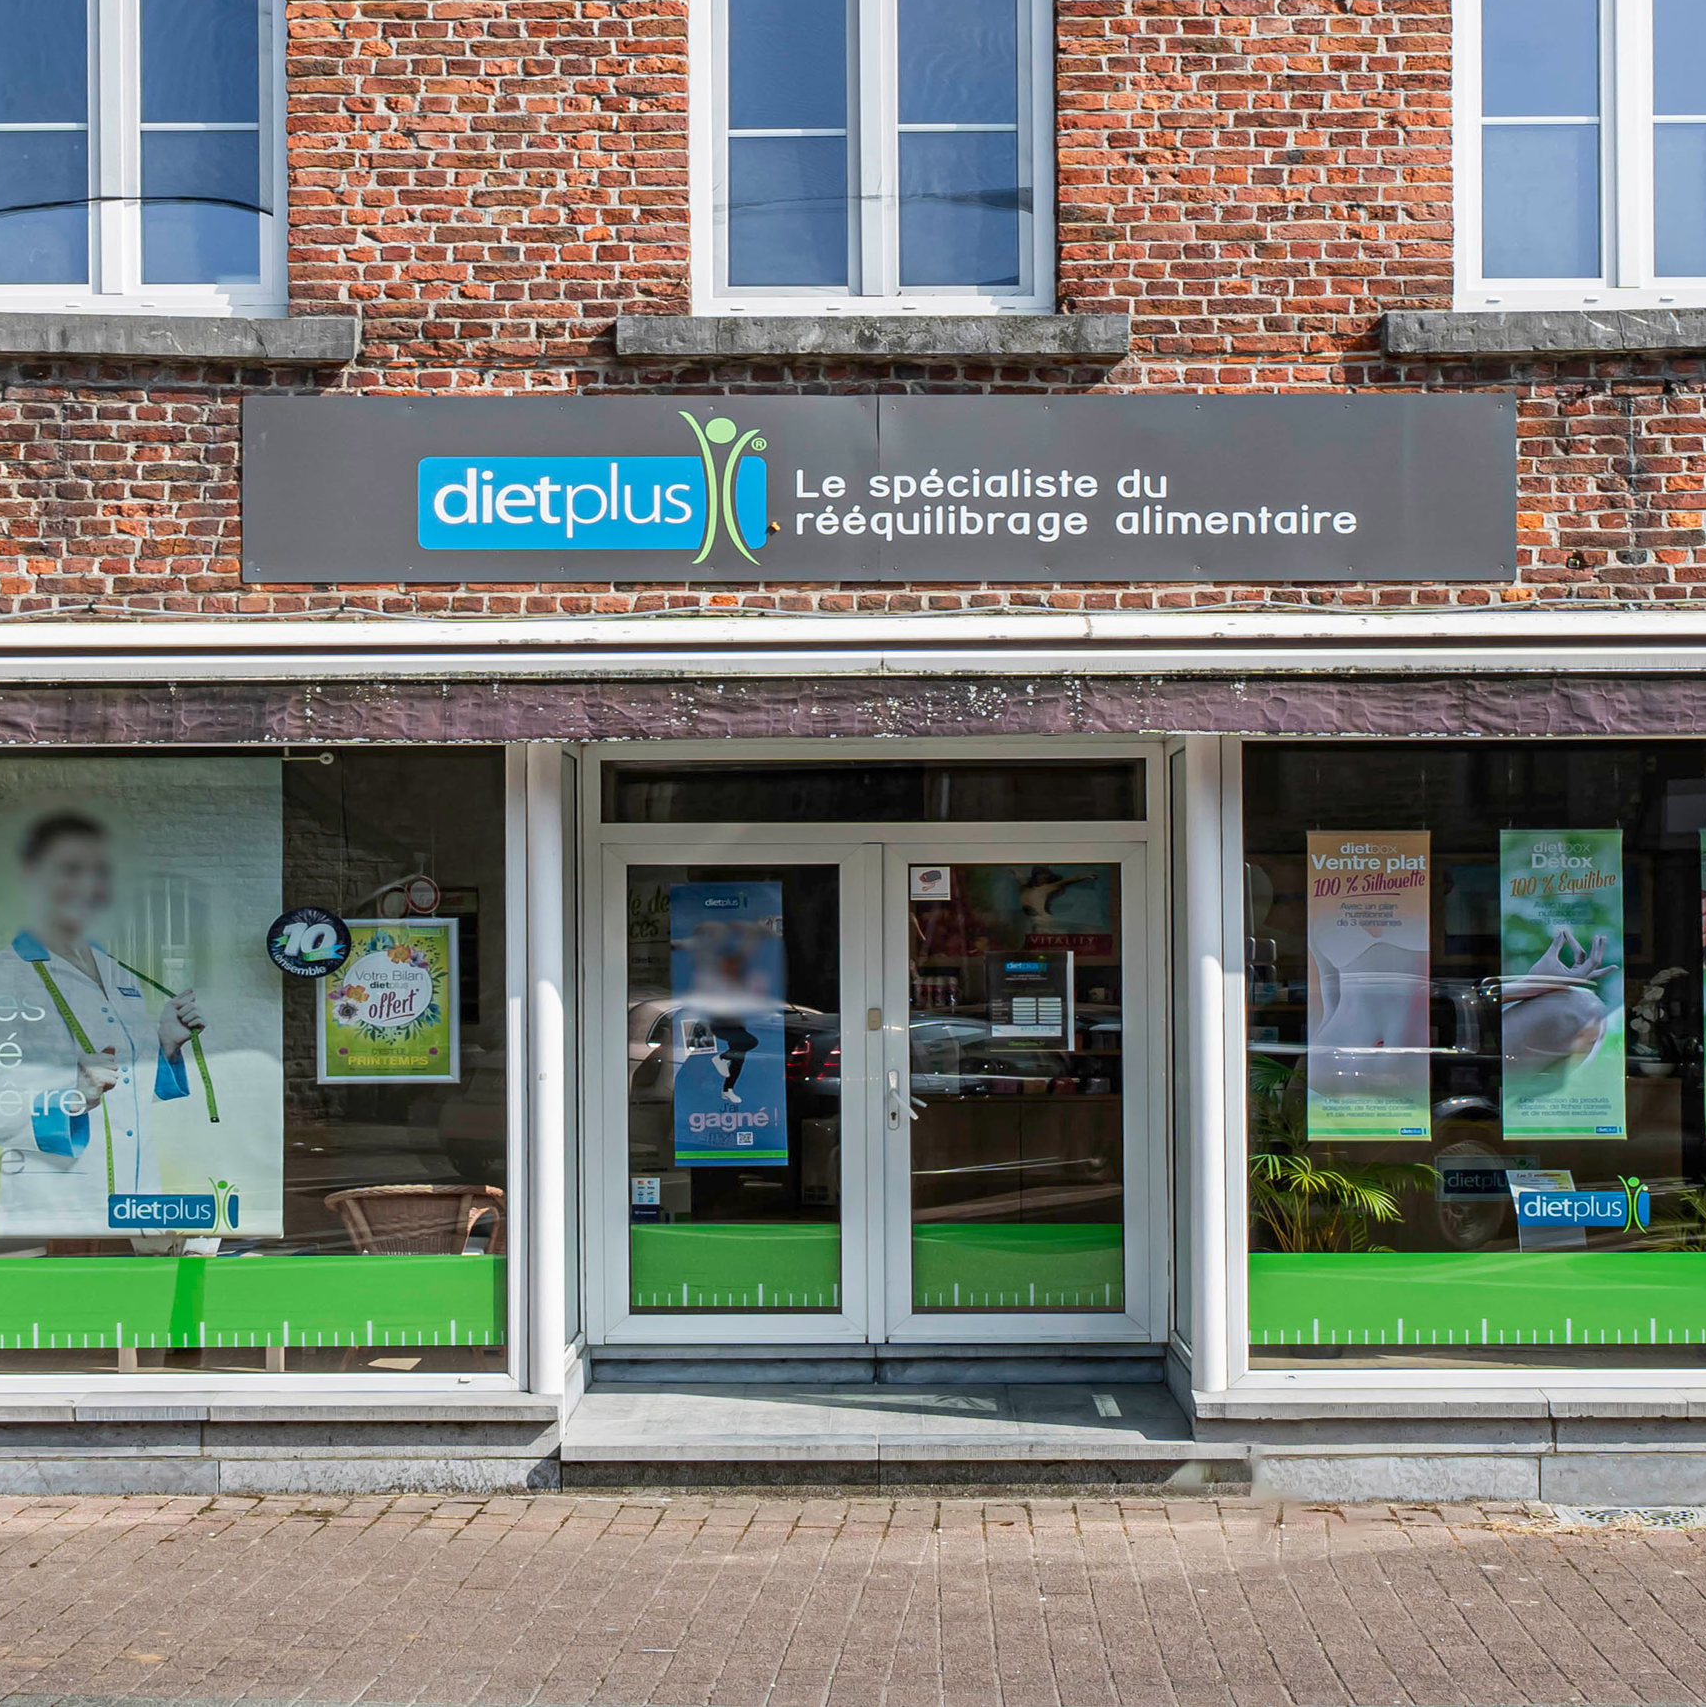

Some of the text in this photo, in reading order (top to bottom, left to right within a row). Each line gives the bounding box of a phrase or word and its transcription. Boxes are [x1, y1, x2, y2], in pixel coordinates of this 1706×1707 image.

[795, 467, 1168, 504] Le spécialiste du
[433, 462, 693, 539] dietplus
[795, 504, 1358, 543] rééquilibrage alimentaire
[1311, 853, 1426, 874] Ventre plat
[1313, 869, 1426, 898] 100 % Silhouette
[1510, 876, 1538, 898] 100
[355, 969, 424, 981] Votre Bilan
[348, 1056, 429, 1065] PRINTEMPS
[688, 1106, 769, 1132] gagné
[1447, 1171, 1507, 1191] dietplu
[113, 1197, 212, 1225] dietplus
[1523, 1195, 1623, 1223] dietplus
